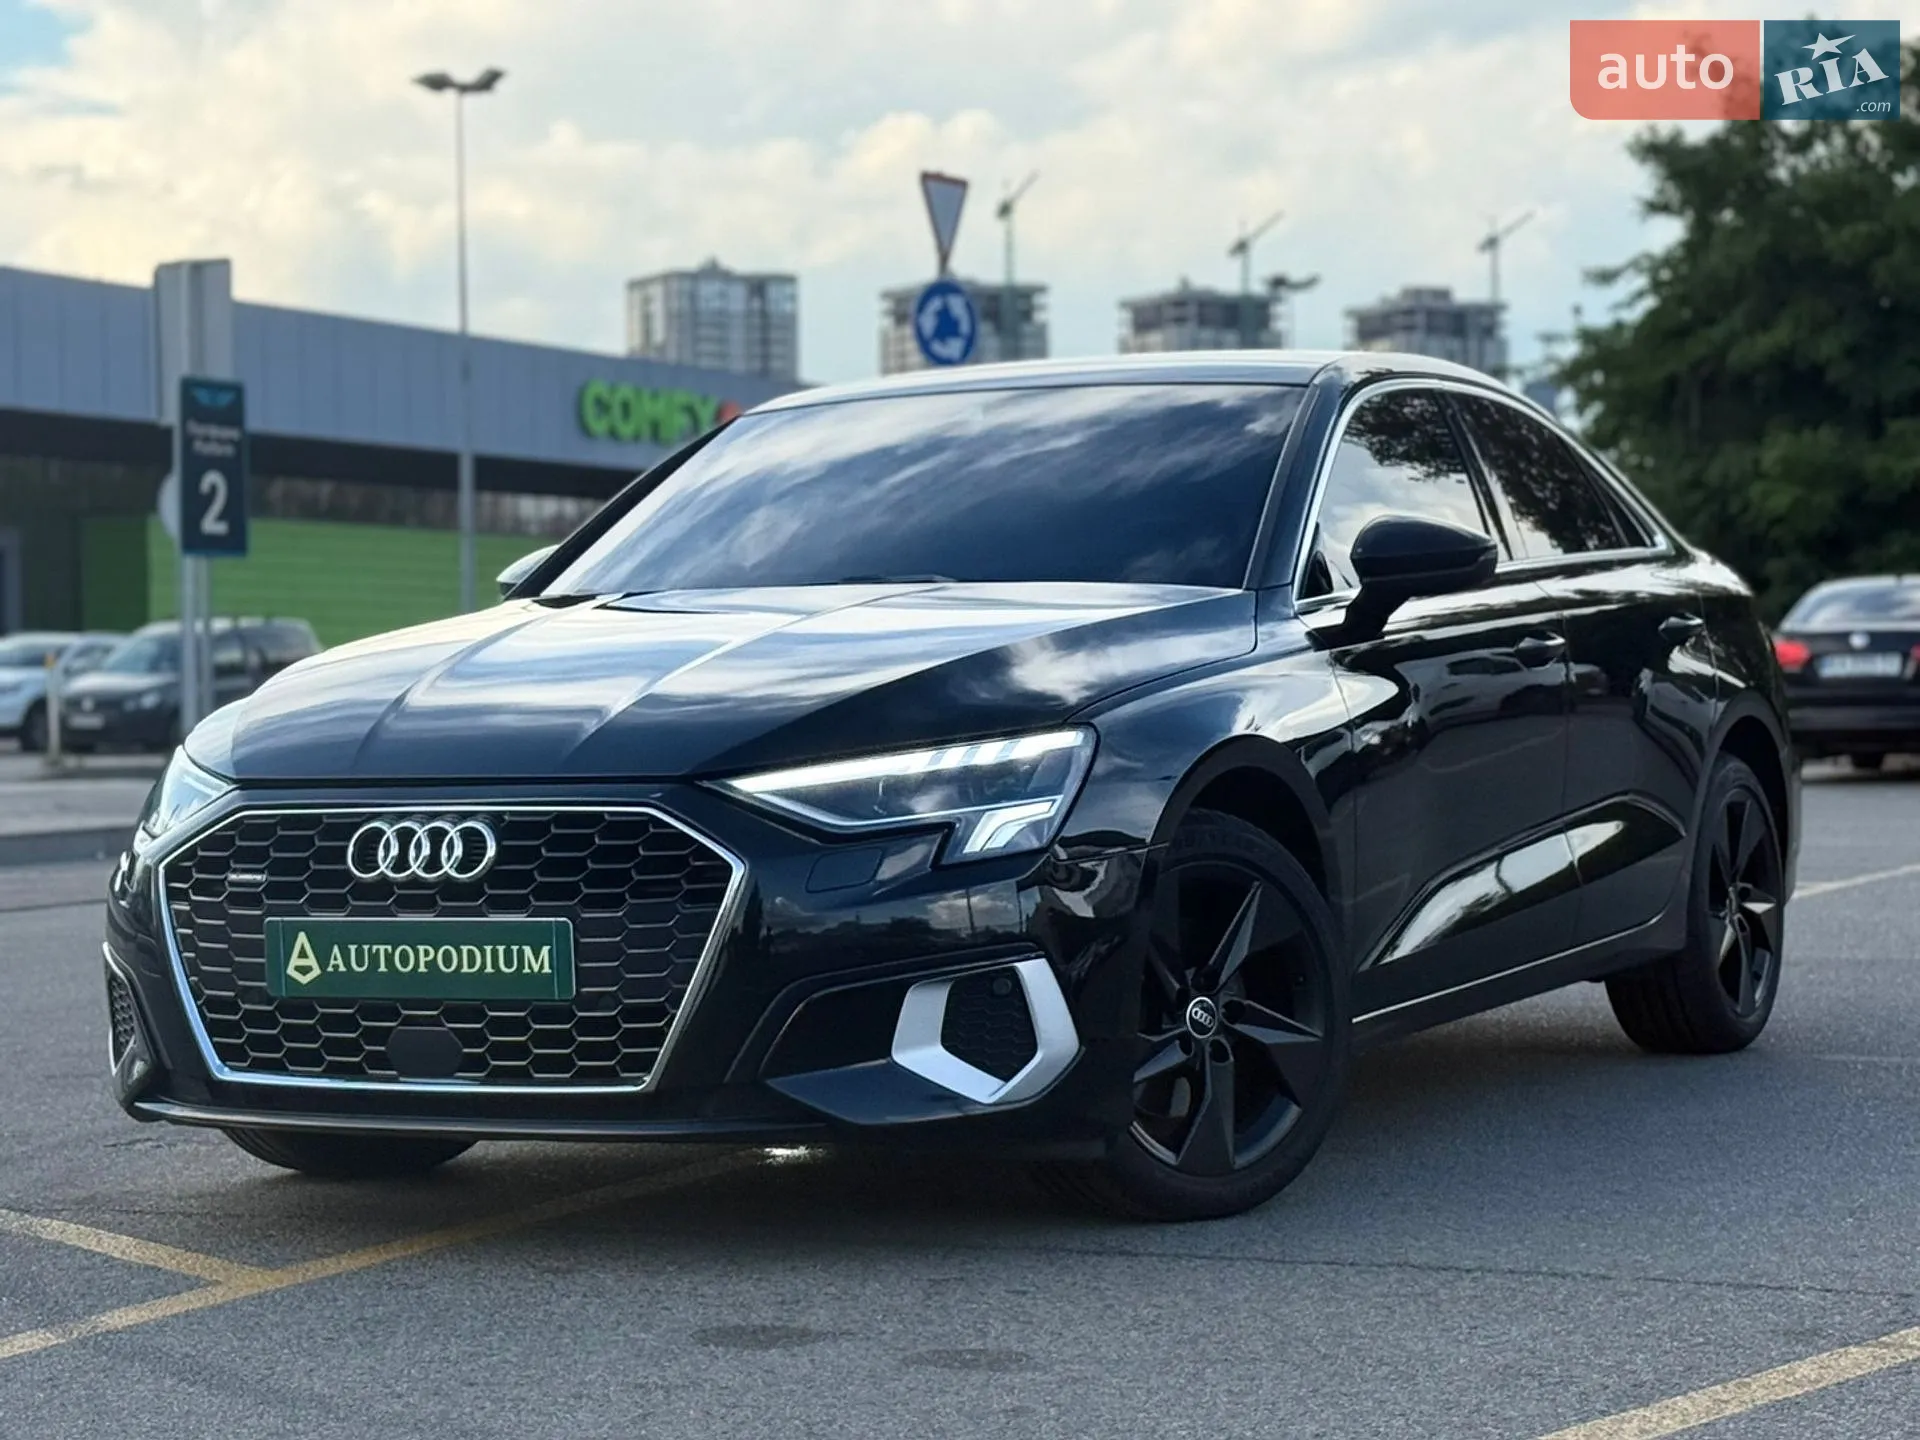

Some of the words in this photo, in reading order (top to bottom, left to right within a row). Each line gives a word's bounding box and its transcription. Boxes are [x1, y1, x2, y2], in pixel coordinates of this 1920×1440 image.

[581, 378, 719, 445] COMFY
[199, 469, 229, 535] 2
[326, 944, 553, 974] AUTOPODIUM
